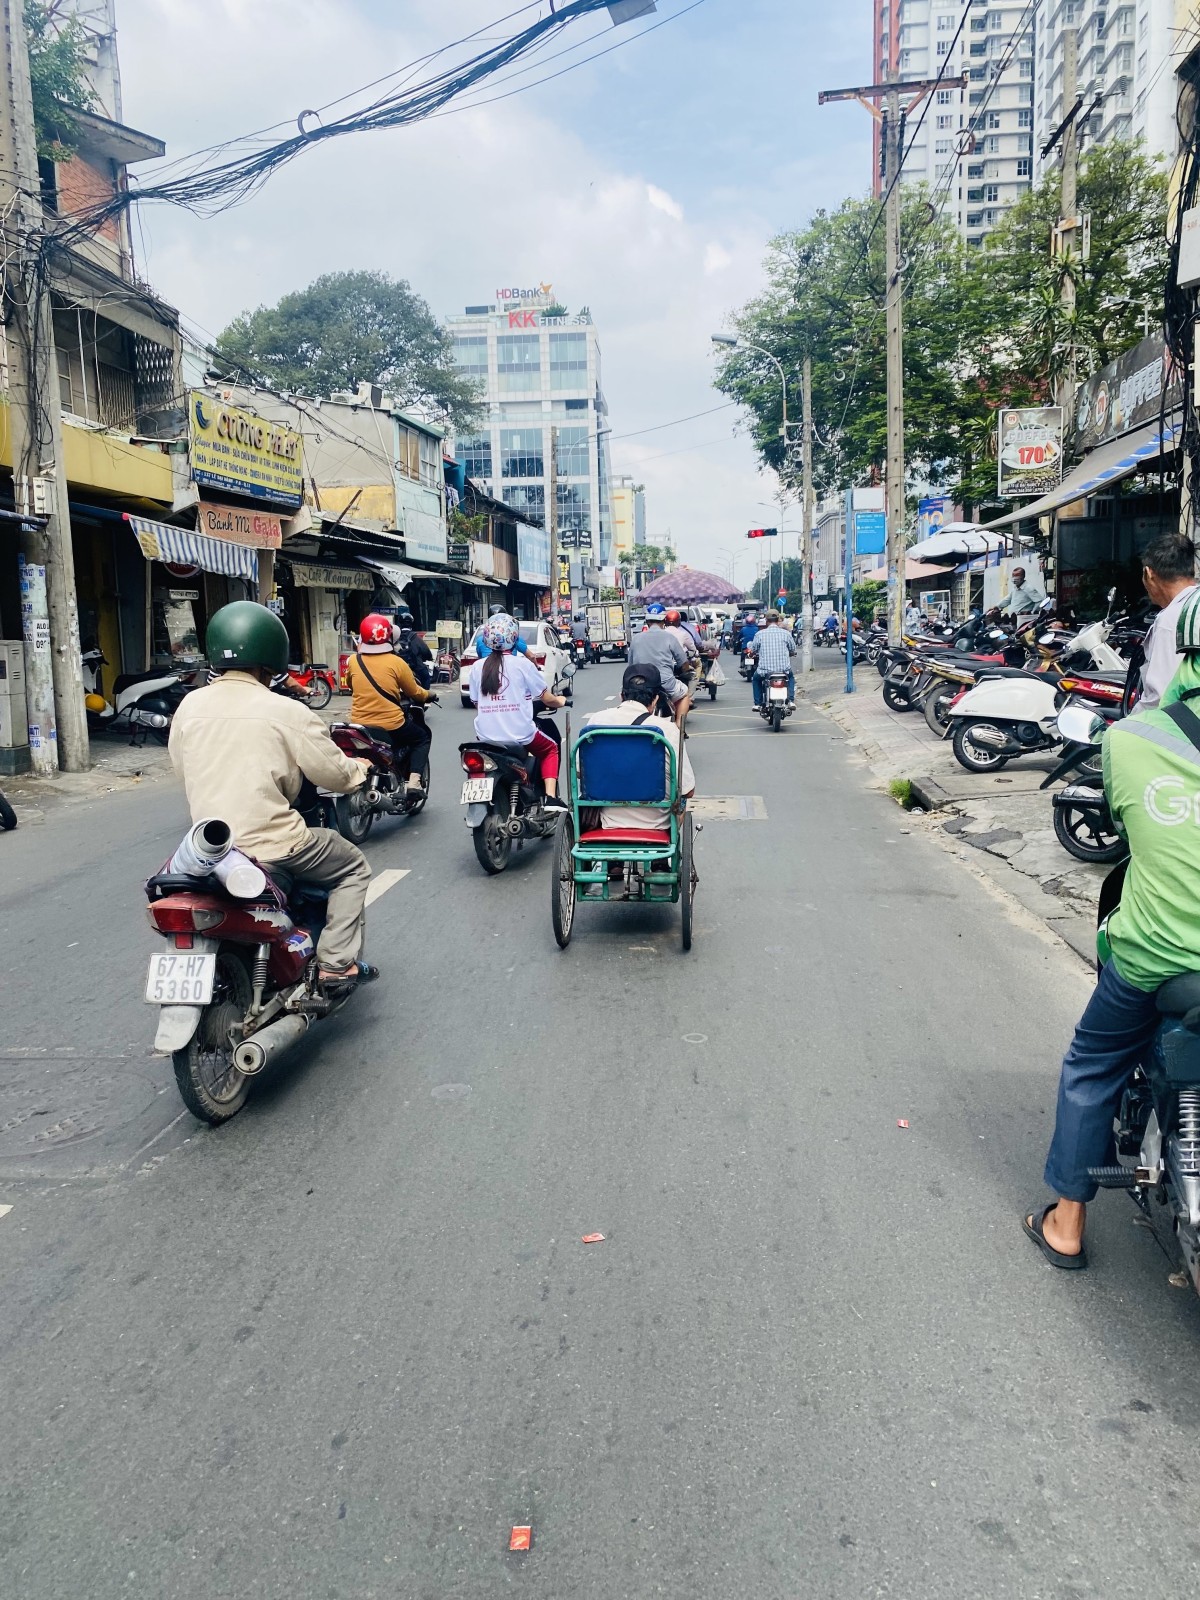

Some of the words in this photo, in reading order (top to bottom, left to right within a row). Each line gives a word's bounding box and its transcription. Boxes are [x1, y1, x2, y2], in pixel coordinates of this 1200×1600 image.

[496, 288, 541, 299] HDBank
[508, 310, 537, 329] KK
[217, 411, 264, 450] CƯỜNG
[1007, 429, 1056, 441] COFFEE
[1018, 446, 1045, 465] 170
[207, 511, 234, 531] Bánh
[253, 515, 280, 537] Gala
[157, 956, 206, 977] 67-H7
[155, 979, 203, 1000] 5360
